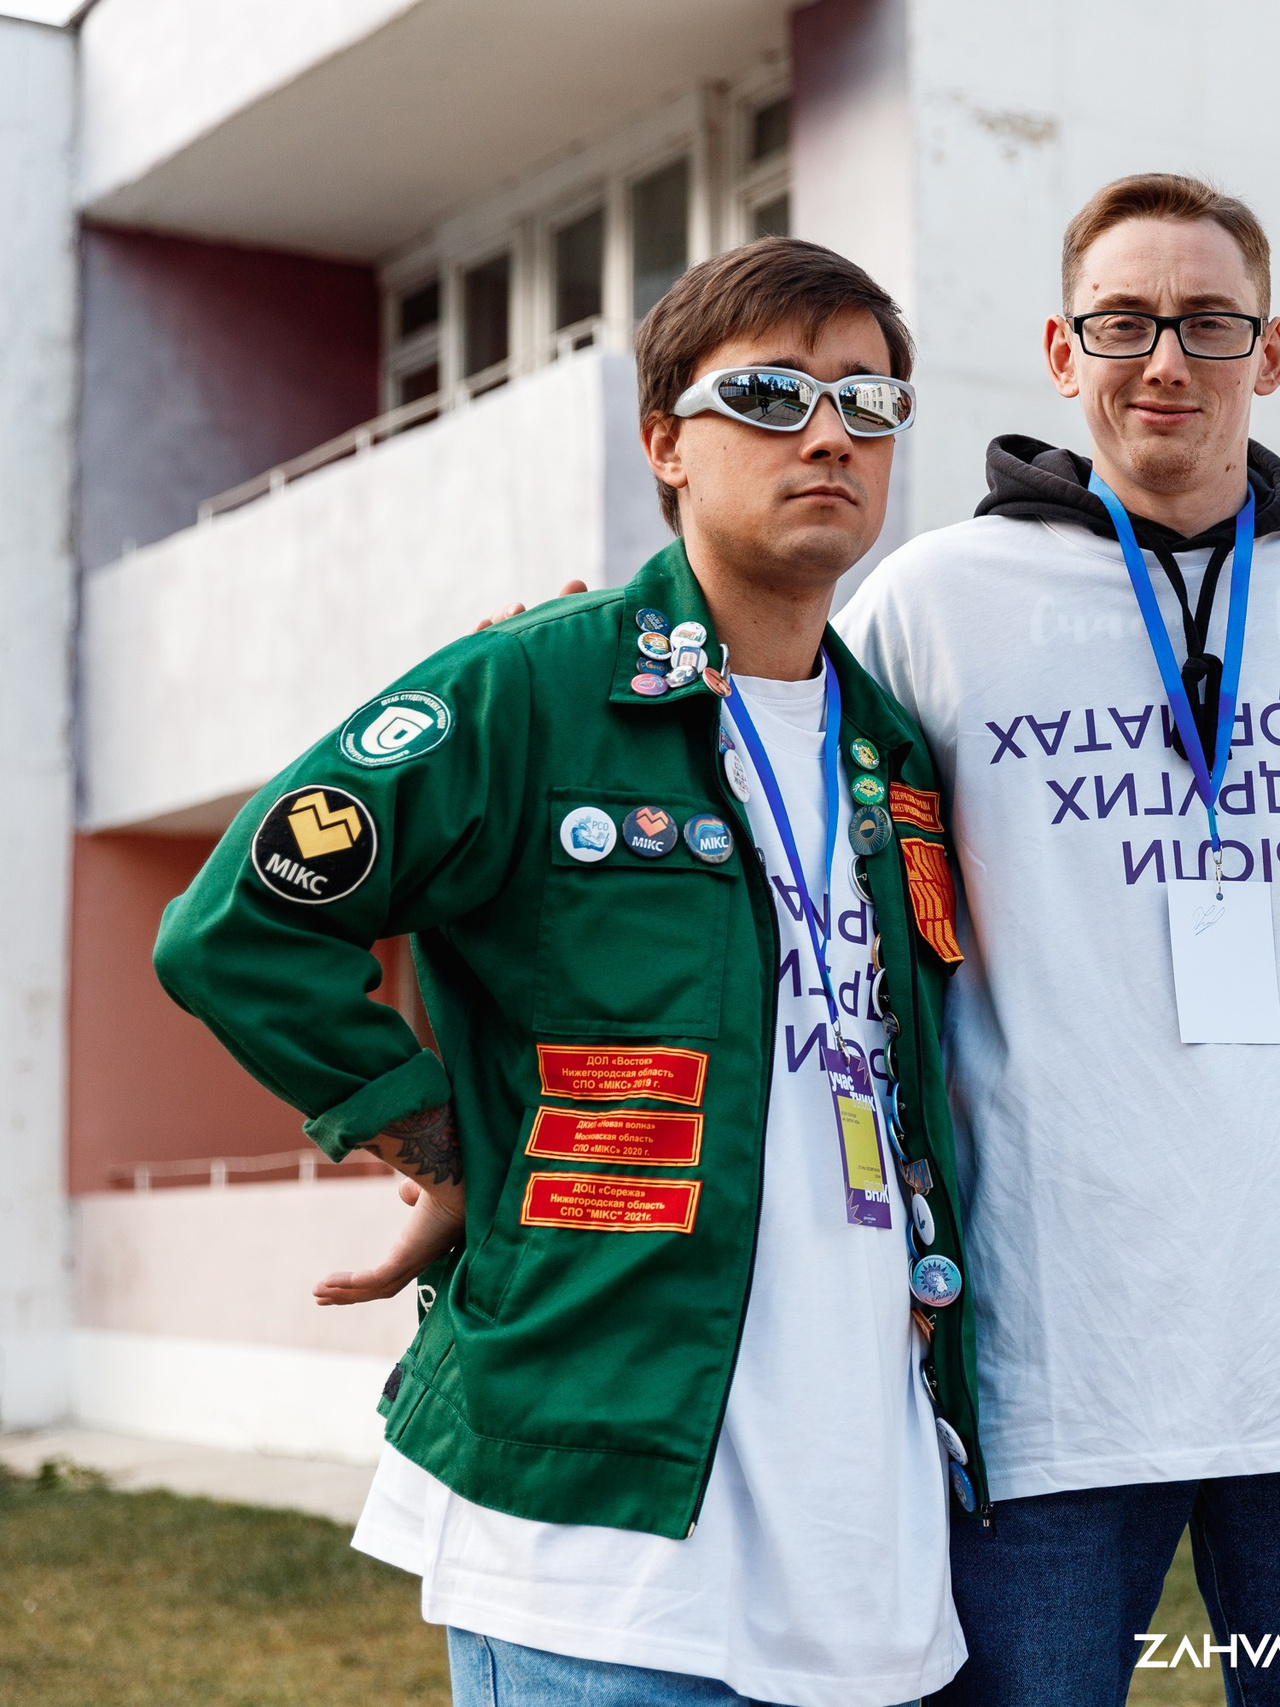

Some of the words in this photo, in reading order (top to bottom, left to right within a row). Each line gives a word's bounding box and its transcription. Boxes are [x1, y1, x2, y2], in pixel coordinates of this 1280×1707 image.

[592, 821, 609, 831] РСО
[586, 1056, 609, 1066] ДОЛ
[611, 1057, 653, 1066] «Восток»
[562, 1068, 636, 1079] Нижегородская
[638, 1068, 674, 1078] область
[573, 1080, 595, 1089] СПО
[633, 1079, 651, 1088] 2019
[653, 1080, 661, 1089] г.
[829, 1070, 855, 1092] учас
[597, 1120, 623, 1129] «Новая
[625, 1122, 655, 1130] волна»
[574, 1132, 616, 1141] Московская
[618, 1133, 653, 1143] область
[572, 1144, 589, 1152] СПО
[622, 1147, 643, 1155] 2020
[572, 1183, 596, 1194] ДОЦ
[598, 1186, 646, 1198] «Сережа»
[864, 1180, 890, 1204] ВНЖ
[550, 1193, 624, 1208] Нижегородская
[627, 1199, 665, 1210] область
[560, 1207, 583, 1217] СПО
